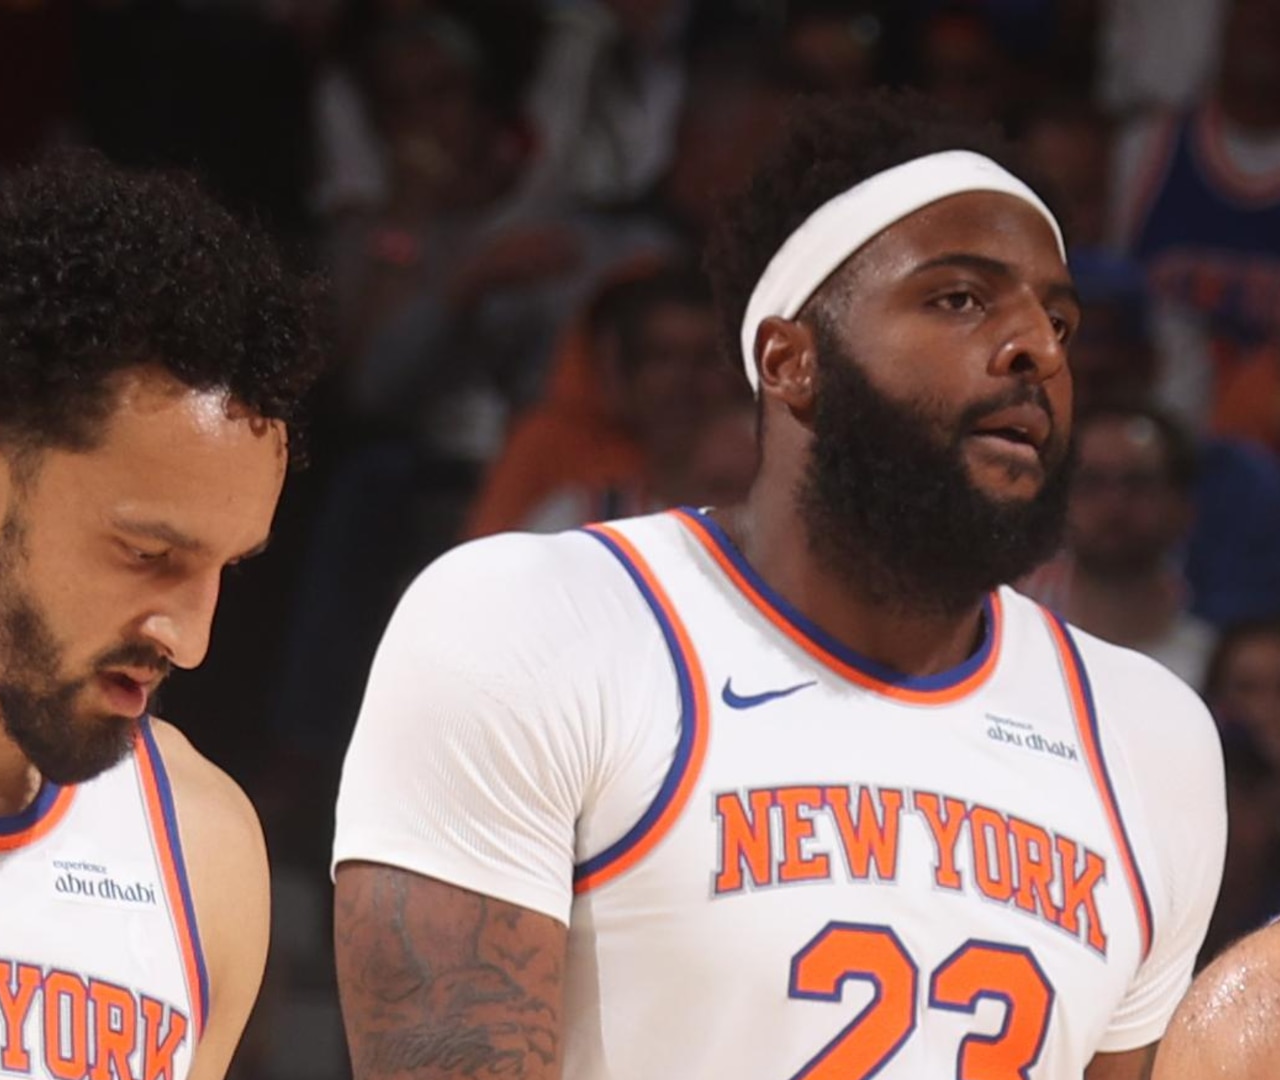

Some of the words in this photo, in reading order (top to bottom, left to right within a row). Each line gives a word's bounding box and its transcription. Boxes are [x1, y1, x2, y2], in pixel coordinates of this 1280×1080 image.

[987, 726, 1023, 746] abu
[1025, 733, 1079, 762] dhabi
[55, 873, 95, 897] abu
[98, 877, 157, 906] dhabi
[711, 784, 904, 898] NEW
[909, 788, 1107, 960] YORK
